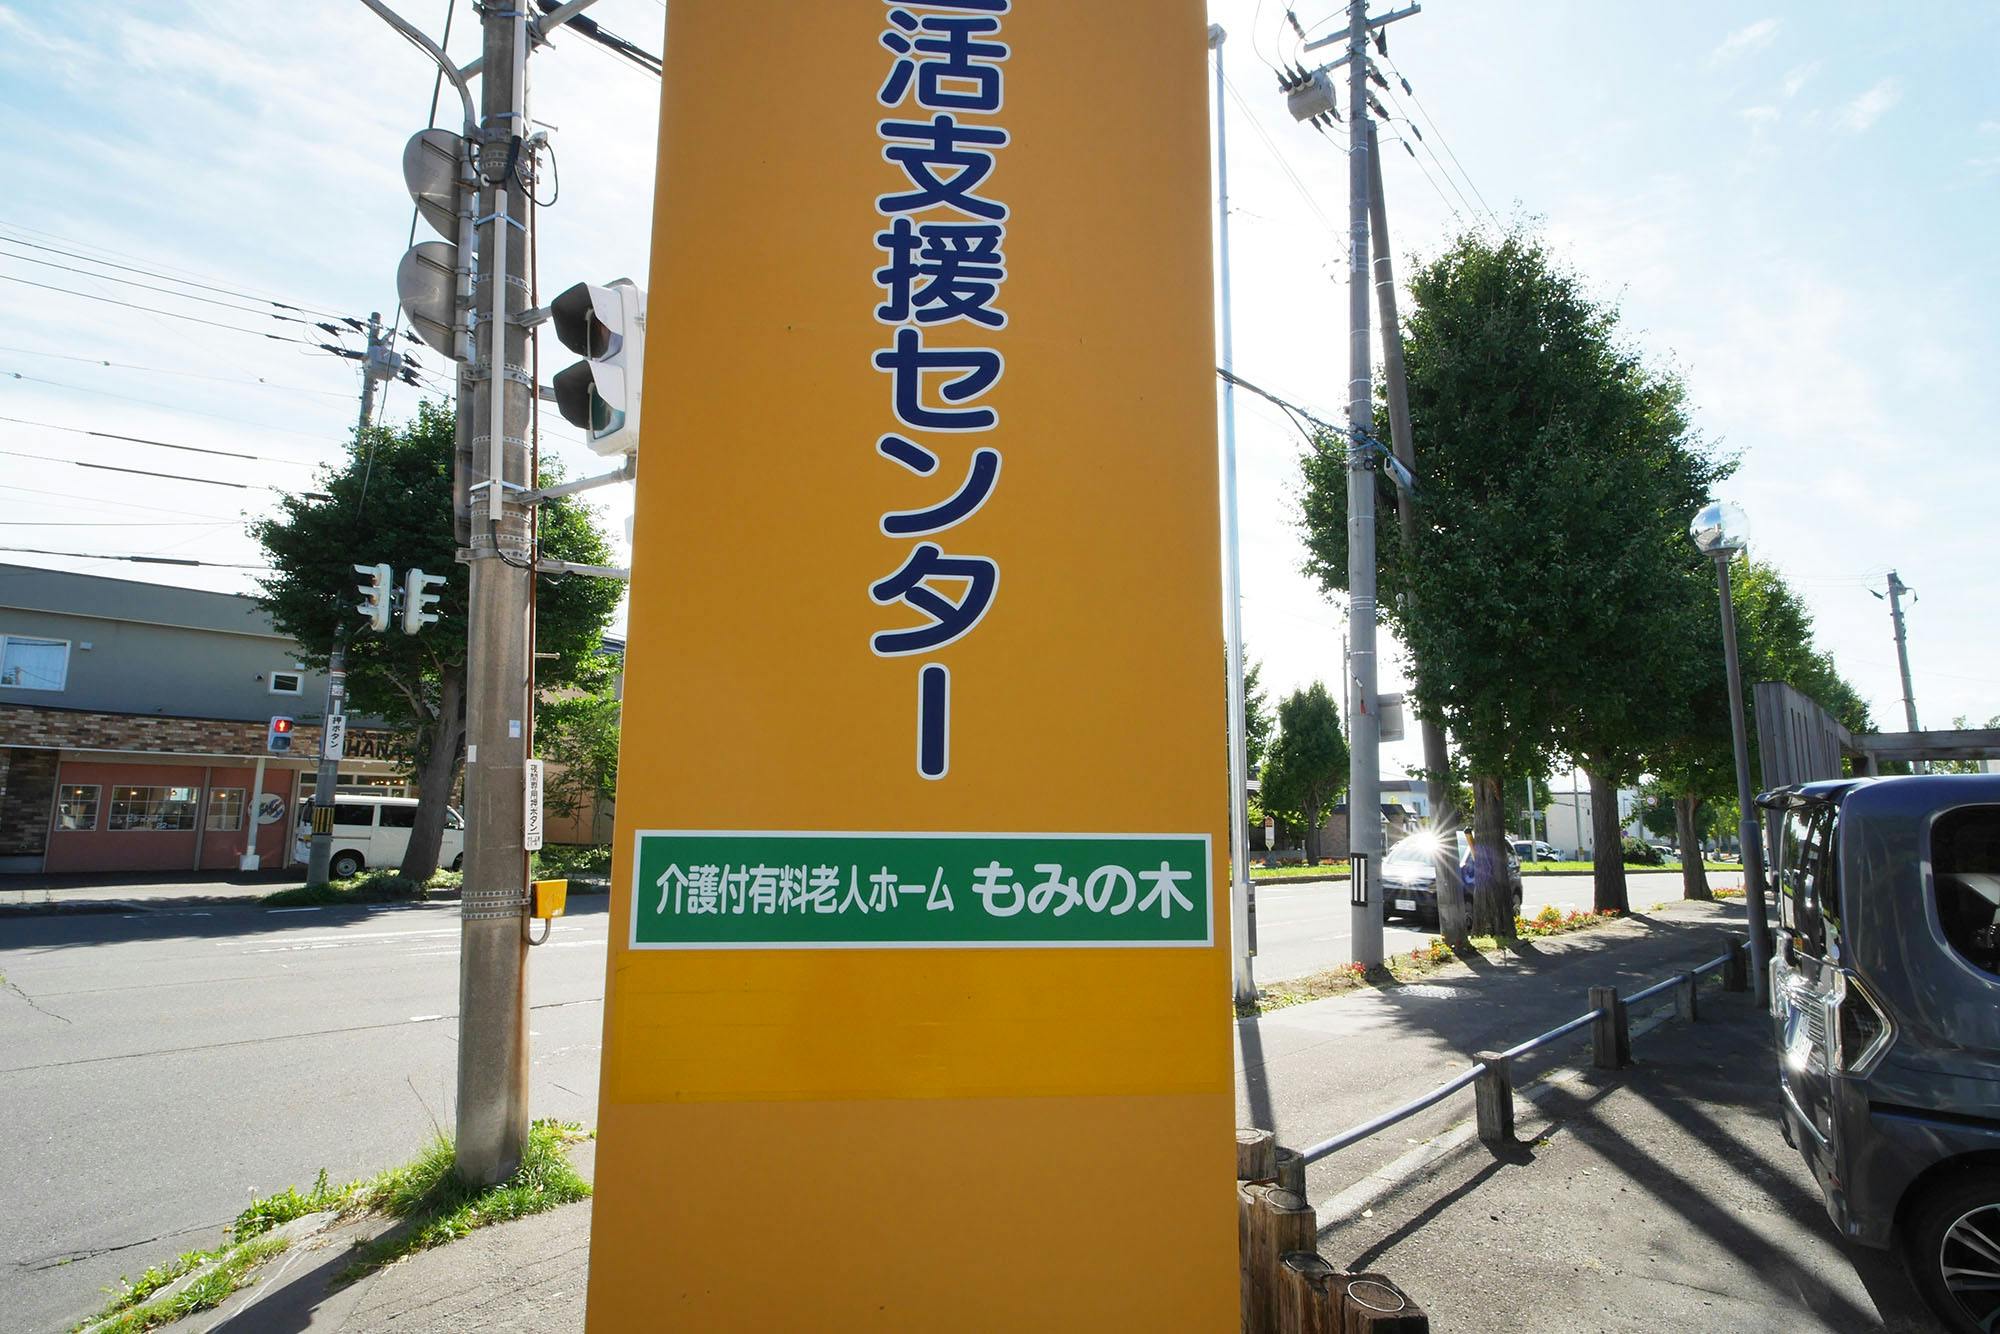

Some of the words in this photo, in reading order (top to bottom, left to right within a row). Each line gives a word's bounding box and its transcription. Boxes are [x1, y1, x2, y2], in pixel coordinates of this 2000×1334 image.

[866, 0, 1012, 780] 活支援センター
[330, 716, 343, 749] 押ボタン
[656, 863, 954, 915] 介護付有料老人ホーム
[972, 860, 1194, 919] もみの木
